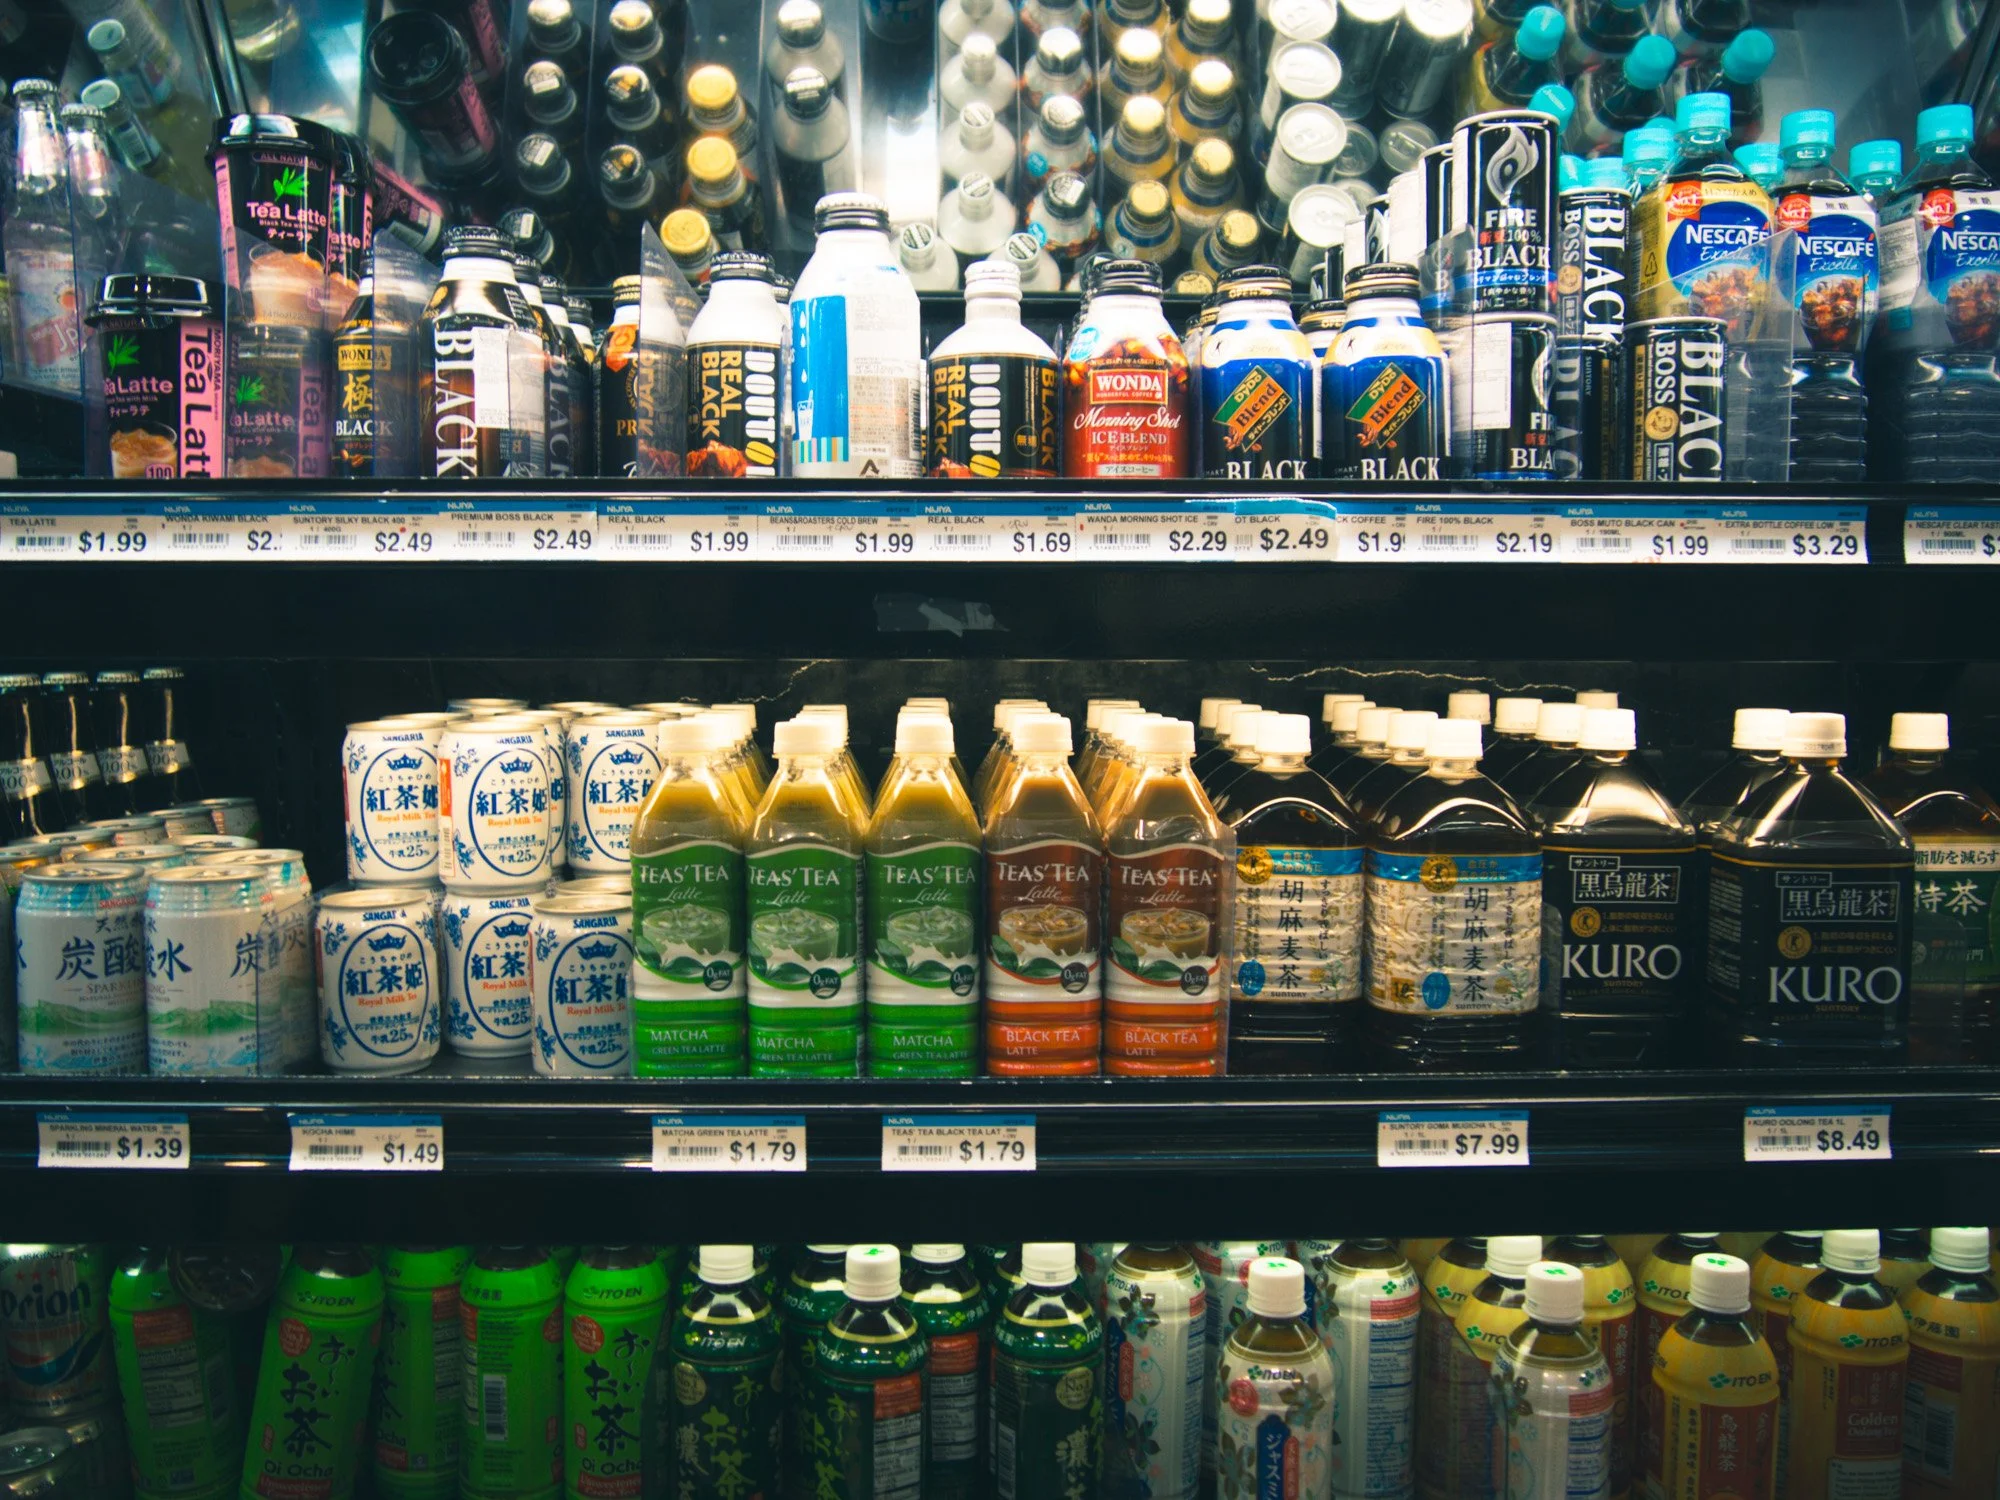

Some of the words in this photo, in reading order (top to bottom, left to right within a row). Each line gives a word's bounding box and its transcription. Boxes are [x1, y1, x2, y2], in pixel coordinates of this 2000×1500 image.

[285, 203, 327, 227] Latte
[1485, 209, 1537, 228] FIRE
[1508, 229, 1541, 244] 100%
[1562, 207, 1581, 264] BOSS
[1467, 245, 1551, 270] BLACK
[1810, 257, 1860, 272] Excella
[1584, 206, 1626, 345] BLACK
[214, 329, 223, 392] MORIYAMA
[340, 349, 387, 361] WONDA
[1096, 374, 1162, 391] WONDA
[1655, 341, 1677, 405] BOSS
[701, 350, 720, 438] BLACK
[720, 350, 742, 418] REAL
[1233, 372, 1263, 403] DyDo
[434, 329, 477, 477] BLACK
[947, 364, 967, 435] REAL
[1235, 384, 1278, 429] Blend
[1369, 380, 1412, 425] Blend
[933, 367, 948, 455] BLACK
[1073, 406, 1145, 430] Morning
[1146, 405, 1182, 431] Shot
[336, 420, 393, 437] BLACK
[1091, 430, 1118, 445] ICE
[1120, 431, 1167, 445] BLEND
[1105, 466, 1155, 474] アイスコーヒー
[1361, 456, 1440, 479] BLACK
[9, 518, 27, 526] TEA
[29, 518, 57, 526] LATTE
[293, 517, 333, 525] SUNTORY
[335, 517, 360, 525] SILKY
[362, 517, 390, 525] BLACK
[451, 513, 494, 521] PREMIUM
[496, 513, 522, 521] BOSS
[524, 513, 554, 521] BLACK
[609, 516, 632, 524] REAL
[635, 516, 665, 524] BLACK
[770, 517, 835, 525] BEANS&ROASTERS
[837, 517, 857, 525] COLD
[857, 517, 878, 525] BREW
[928, 516, 951, 524] REAL
[954, 516, 985, 524] BLACK
[1087, 515, 1118, 523] WANDA
[1120, 515, 1158, 523] MORNING
[1157, 515, 1183, 523] SHOT
[1184, 515, 1198, 523] ICE
[1417, 516, 1437, 524] FIRE
[1439, 516, 1461, 524] 100%
[1463, 516, 1493, 524] BLACK
[1571, 519, 1595, 527] BOSS
[1597, 519, 1623, 527] MUTO
[1625, 519, 1654, 527] BLACK
[1656, 519, 1675, 527] CAN
[1725, 521, 1751, 529] EXTRA
[1753, 521, 1783, 529] BOTTLE
[1784, 521, 1816, 529] COFFEE
[1817, 521, 1834, 530] LOW
[79, 530, 147, 554] $1.99
[375, 532, 432, 552] $2.49
[533, 528, 592, 550] $2.49
[691, 531, 748, 552] $1.99
[856, 532, 913, 553] $1.99
[1013, 532, 1071, 553] $1.69
[1169, 530, 1227, 552] $2.29
[1260, 528, 1329, 551] $2.49
[1496, 531, 1552, 553] $2.19
[1653, 535, 1708, 556] $1.99
[1793, 533, 1858, 557] $3.29
[606, 728, 645, 738] SANGARIA
[366, 783, 438, 812] 紅茶姫
[476, 788, 547, 817] 紅茶姫
[1574, 859, 1616, 868] サントリー
[1915, 850, 1999, 865] 脂肪を減らす
[640, 864, 688, 884] TEAS'
[691, 863, 729, 883] TEA
[749, 866, 797, 886] TEAS'
[800, 866, 840, 887] TEA
[883, 864, 939, 884] TEAS'
[943, 865, 976, 884] TEA
[996, 862, 1049, 882] TEAS'
[1051, 863, 1090, 882] TEA
[1120, 865, 1172, 886] TEAS'
[1173, 867, 1213, 887] TEA
[1781, 875, 1827, 883] サントリー
[1578, 871, 1673, 899] 黒烏龍茶
[1786, 888, 1890, 917] 黒烏龍茶
[574, 916, 618, 929] SANGARIA
[1276, 879, 1304, 990] 胡麻麦茶
[1463, 886, 1490, 1001] 胡麻麦茶
[1562, 944, 1682, 980] KURO
[345, 961, 423, 997] 紅茶姫
[1769, 966, 1903, 1004] KURO
[567, 1005, 592, 1016] Royal
[594, 1004, 615, 1014] Milk
[651, 1029, 709, 1042] MATCHA
[756, 1037, 815, 1049] MATCHA
[893, 1035, 954, 1047] MATCHA
[1007, 1031, 1050, 1043] BLACK
[1055, 1031, 1081, 1042] TEA
[1125, 1032, 1169, 1044] BLACK
[1173, 1032, 1199, 1044] TEA
[681, 1045, 697, 1054] TEA
[698, 1045, 725, 1053] LATTE
[1007, 1046, 1038, 1056] LATTE
[1125, 1047, 1157, 1057] LATTE
[50, 1125, 93, 1133] SPARKLING
[95, 1125, 127, 1133] MINERAL
[129, 1125, 158, 1133] WATER
[302, 1128, 332, 1136] KOCHA
[334, 1128, 356, 1136] HIME
[662, 1129, 695, 1137] MATCHA
[698, 1129, 724, 1137] GREEN
[726, 1129, 743, 1137] TEA
[744, 1129, 768, 1137] LATTE
[891, 1128, 916, 1136] TEAS'
[918, 1128, 934, 1136] TEA
[936, 1128, 965, 1136] BLACK
[967, 1128, 985, 1136] TEA
[117, 1136, 183, 1159] $1.39
[959, 1140, 1025, 1163] $1.79
[1455, 1133, 1520, 1157] $7.99
[1817, 1129, 1880, 1153] $8.49
[383, 1141, 439, 1165] $1.49
[730, 1141, 796, 1164] $1.79
[600, 1288, 623, 1299] ITO
[624, 1286, 643, 1298] EN
[1731, 1375, 1756, 1388] ITO
[1756, 1372, 1772, 1384] EN
[1848, 1411, 1898, 1428] Golden
[264, 1459, 283, 1477] Oi
[287, 1462, 334, 1478] Ocha
